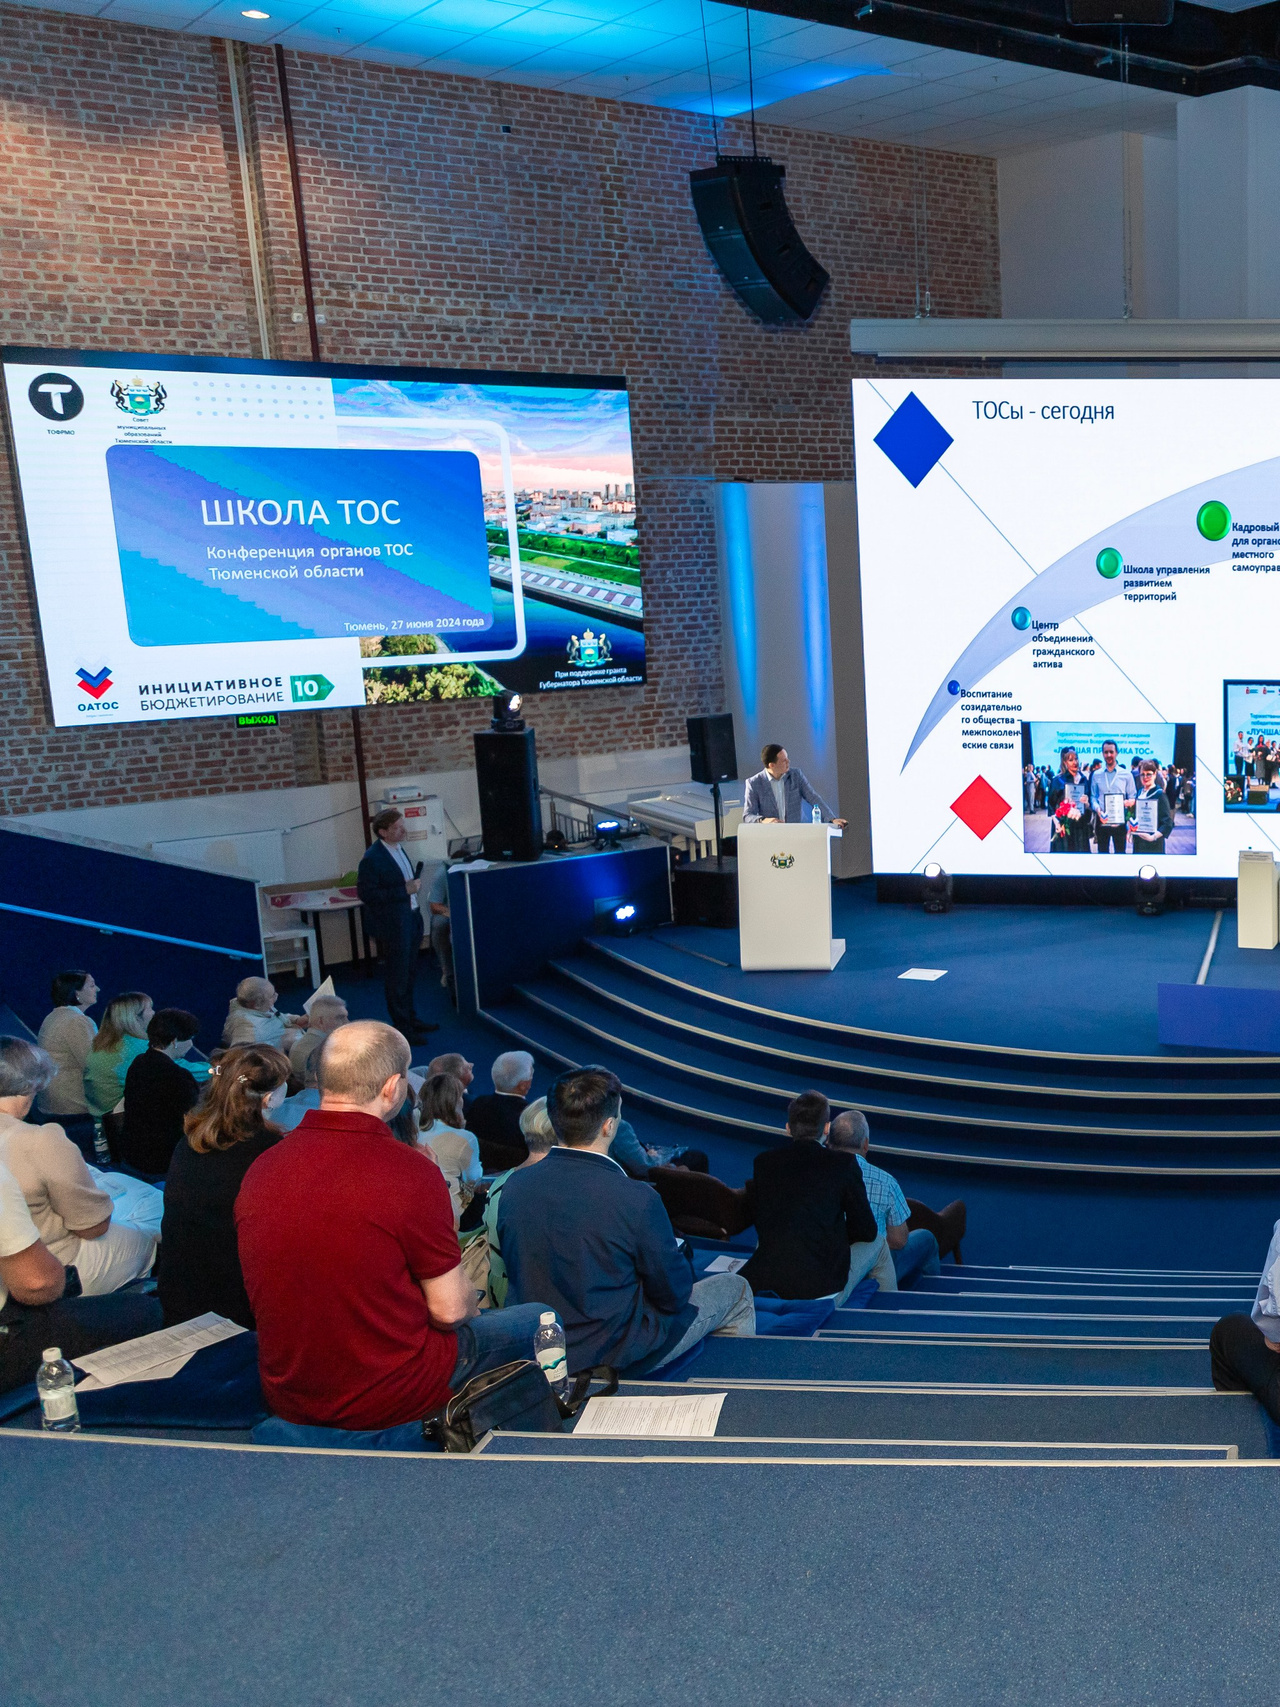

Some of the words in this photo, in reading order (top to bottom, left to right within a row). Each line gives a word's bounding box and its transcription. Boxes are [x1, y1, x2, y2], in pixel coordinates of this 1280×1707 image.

[972, 400, 1023, 420] ТОСы
[1040, 404, 1114, 424] сегодня
[201, 499, 330, 526] ШКОЛА
[337, 500, 400, 525] ТОС
[1232, 522, 1279, 533] Кадровый
[1232, 537, 1249, 546] для
[207, 546, 314, 561] Конференция
[320, 547, 380, 560] органов
[384, 544, 414, 556] ТОС
[1232, 551, 1274, 559] местного
[208, 566, 298, 580] Тюменской
[304, 565, 364, 578] области
[1123, 564, 1154, 575] Школа
[1156, 566, 1210, 578] управления
[1123, 579, 1172, 590] развитием
[1124, 591, 1177, 603] территорий
[344, 622, 389, 632] Тюмень,
[391, 620, 403, 630] 27
[406, 620, 433, 628] июня
[436, 618, 460, 628] 2024
[462, 618, 484, 628] года
[1032, 620, 1059, 631] Центр
[1032, 634, 1093, 644] объединения
[1032, 648, 1095, 657] гражданского
[570, 668, 605, 677] поддержке
[138, 676, 283, 696] ИНИЦИАТИВНОЕ
[294, 680, 318, 696] 10
[540, 681, 580, 690] Губернатора
[581, 677, 616, 685] Тюменской
[961, 690, 1013, 698] Воспитание
[78, 701, 119, 711] ОАТОС
[140, 692, 285, 712] БЮДЖЕТИРОВАНИЕ
[961, 703, 1022, 712] созидательно
[238, 714, 276, 726] ВЫХОД
[972, 715, 1015, 725] общества
[990, 741, 1014, 749] связи
